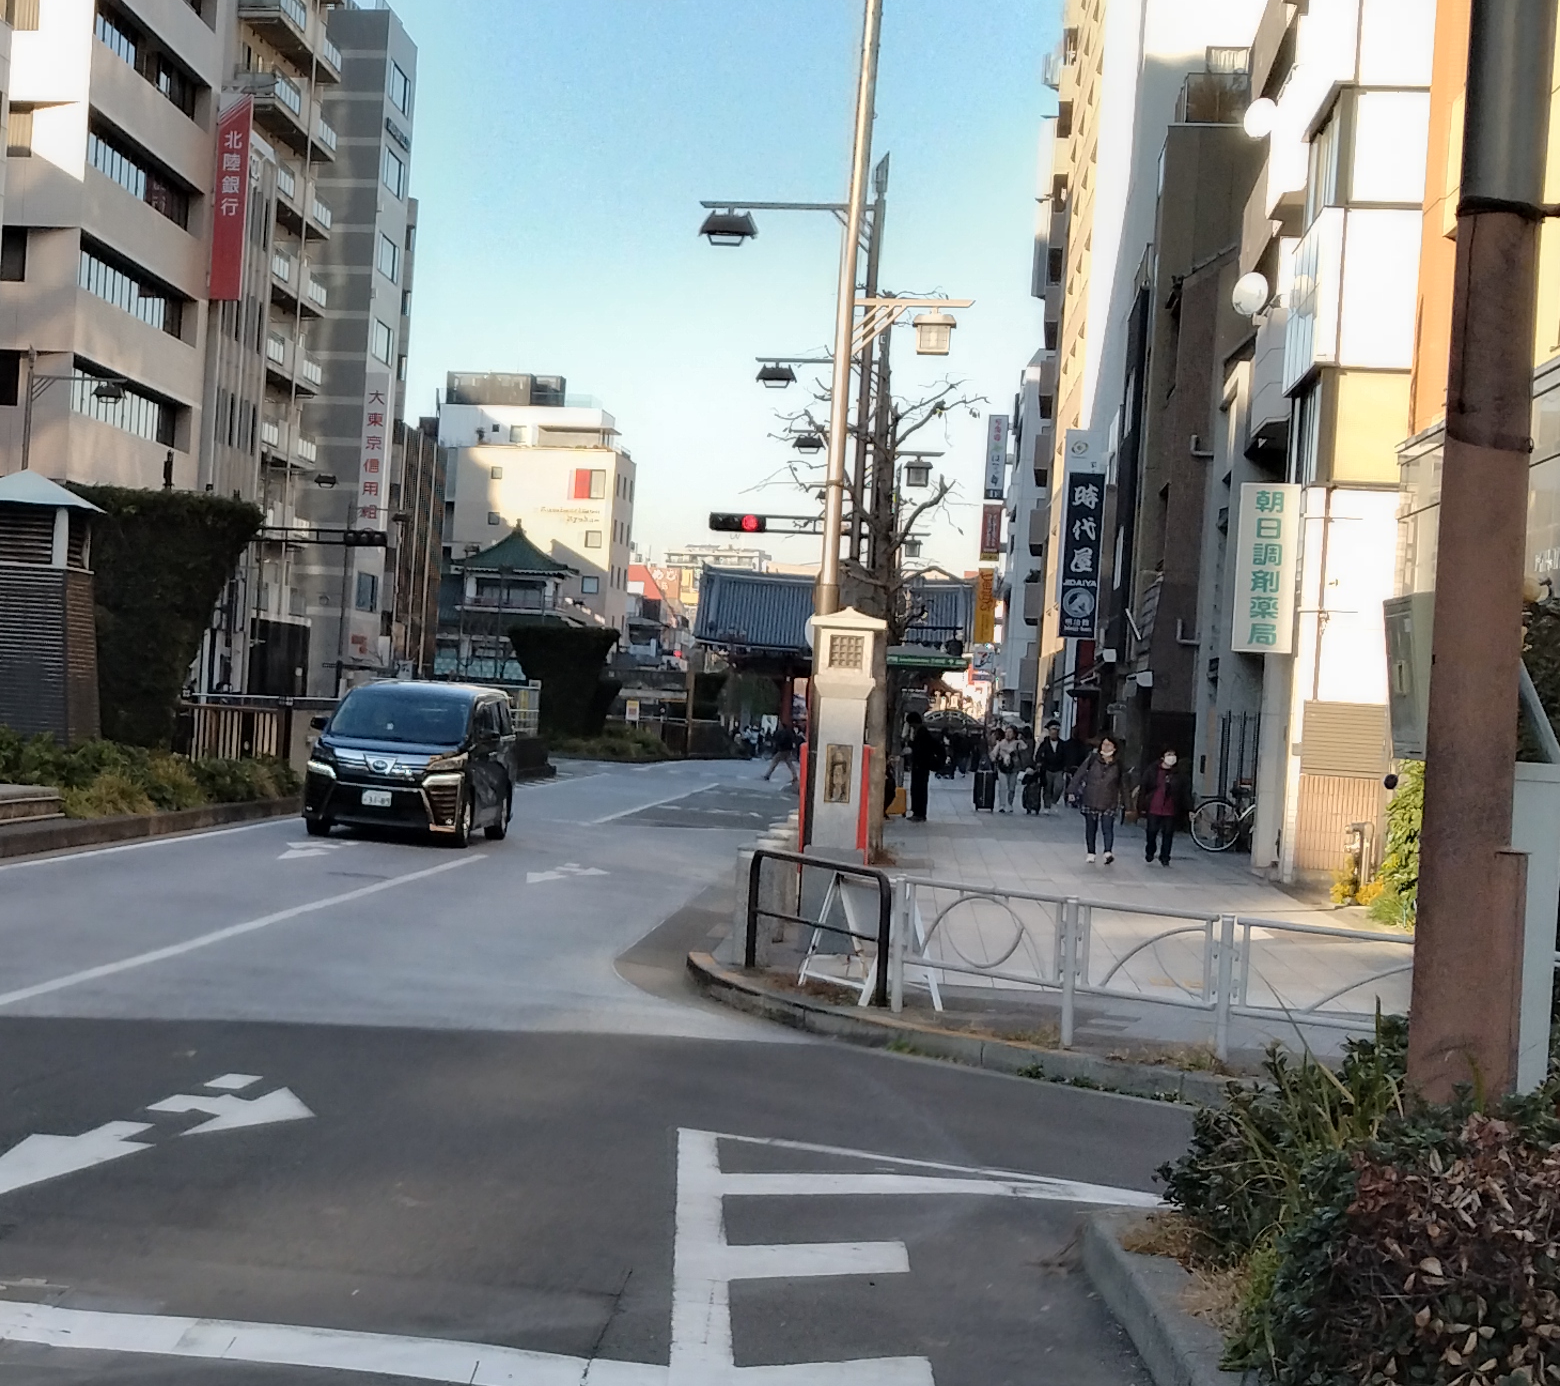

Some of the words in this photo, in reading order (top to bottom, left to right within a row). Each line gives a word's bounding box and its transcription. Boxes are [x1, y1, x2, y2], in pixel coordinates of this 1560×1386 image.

[220, 130, 243, 216] 北陸銀行
[362, 389, 386, 520] 大東京信用組
[1070, 482, 1100, 573] 時代屋
[1247, 489, 1286, 646] 朝日調剤薬局
